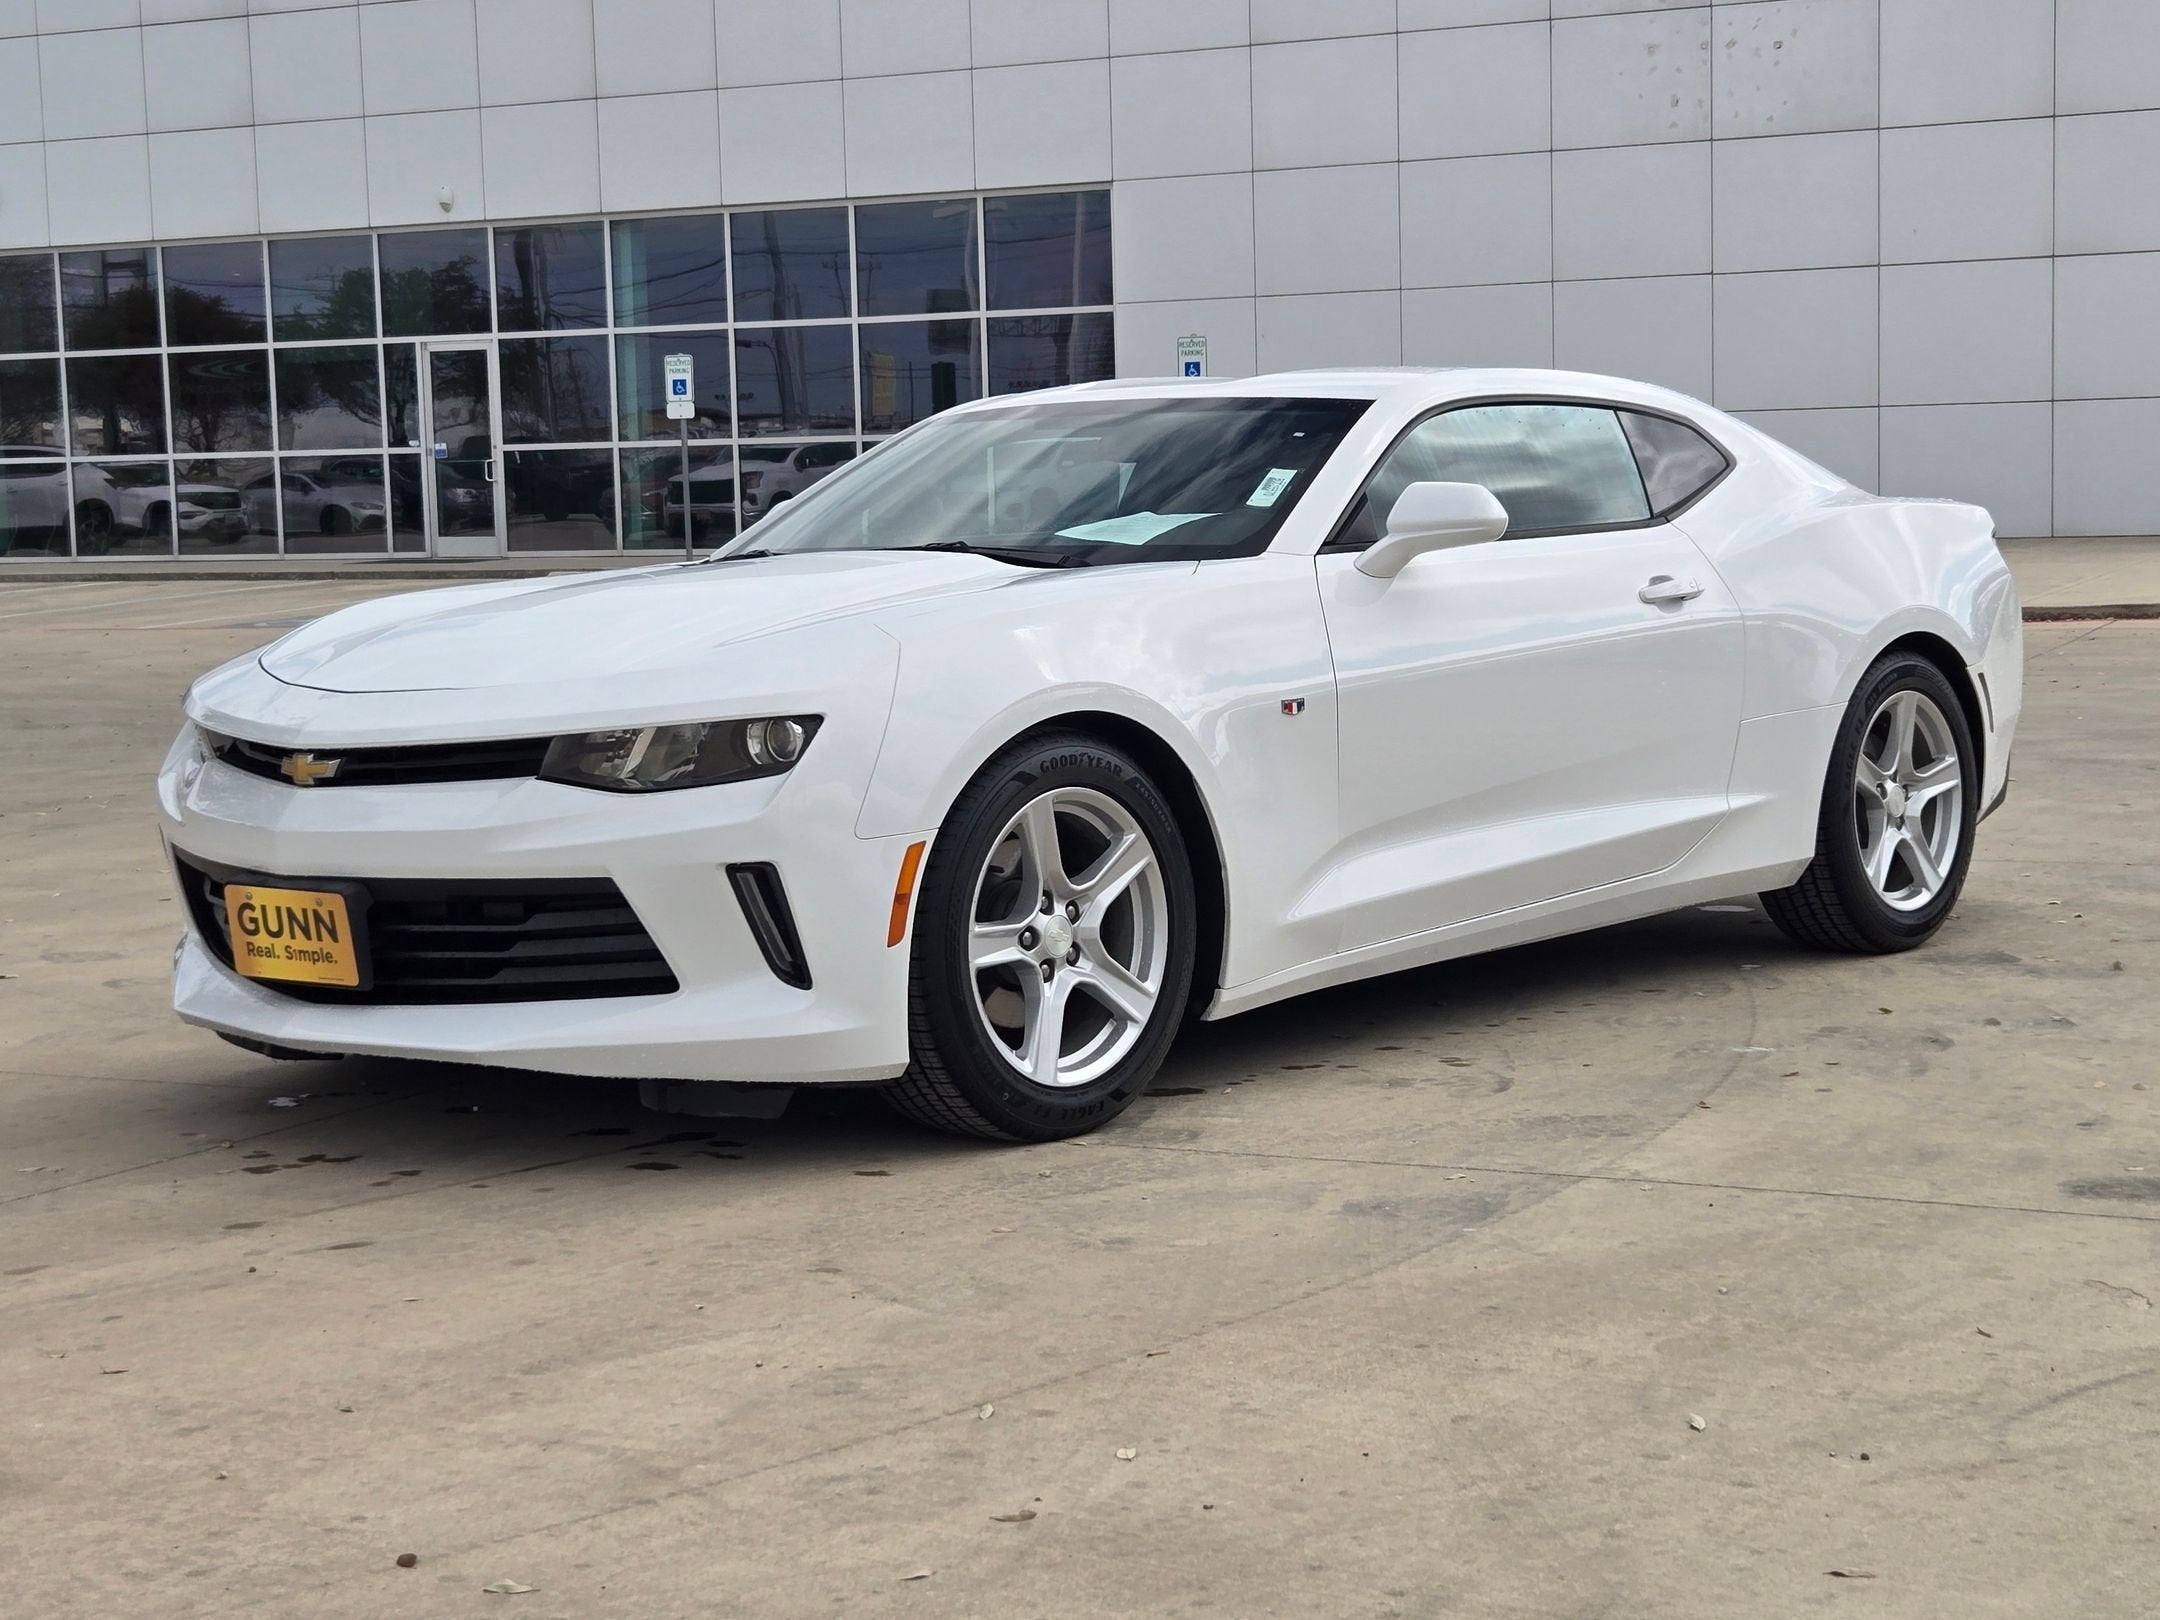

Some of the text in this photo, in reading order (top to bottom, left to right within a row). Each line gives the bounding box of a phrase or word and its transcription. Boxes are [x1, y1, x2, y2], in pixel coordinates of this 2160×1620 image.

[1179, 339, 1205, 348] RESERVED
[1181, 349, 1204, 357] PARKING
[1040, 752, 1122, 777] GOODYEAR
[237, 902, 339, 943] GUNN
[246, 941, 338, 966] Real. Simple.
